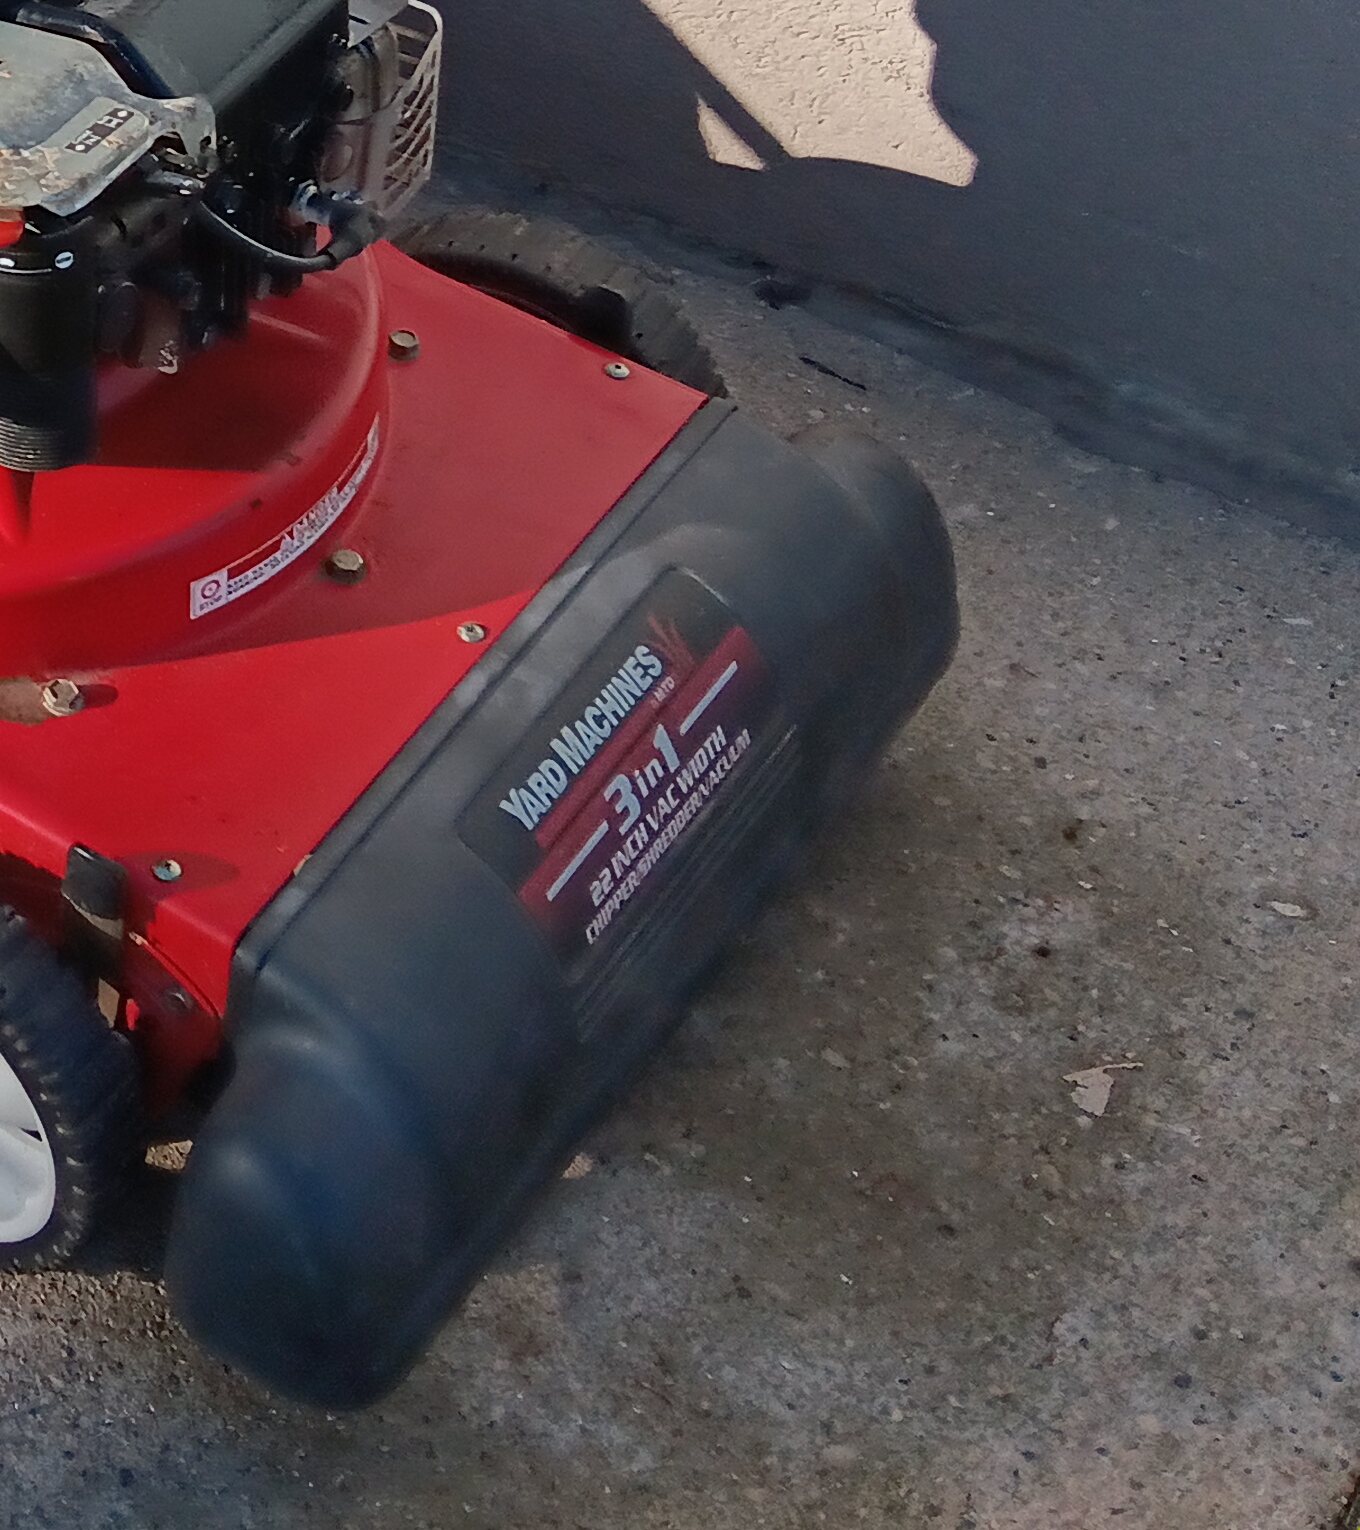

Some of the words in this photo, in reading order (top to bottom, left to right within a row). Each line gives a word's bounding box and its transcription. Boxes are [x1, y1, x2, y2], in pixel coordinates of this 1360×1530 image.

[498, 759, 568, 831] YARD
[549, 645, 663, 775] MACHINES
[589, 867, 614, 907] 22
[610, 822, 649, 879] INCH
[645, 783, 680, 832] VAC
[676, 725, 727, 794] WIDTH
